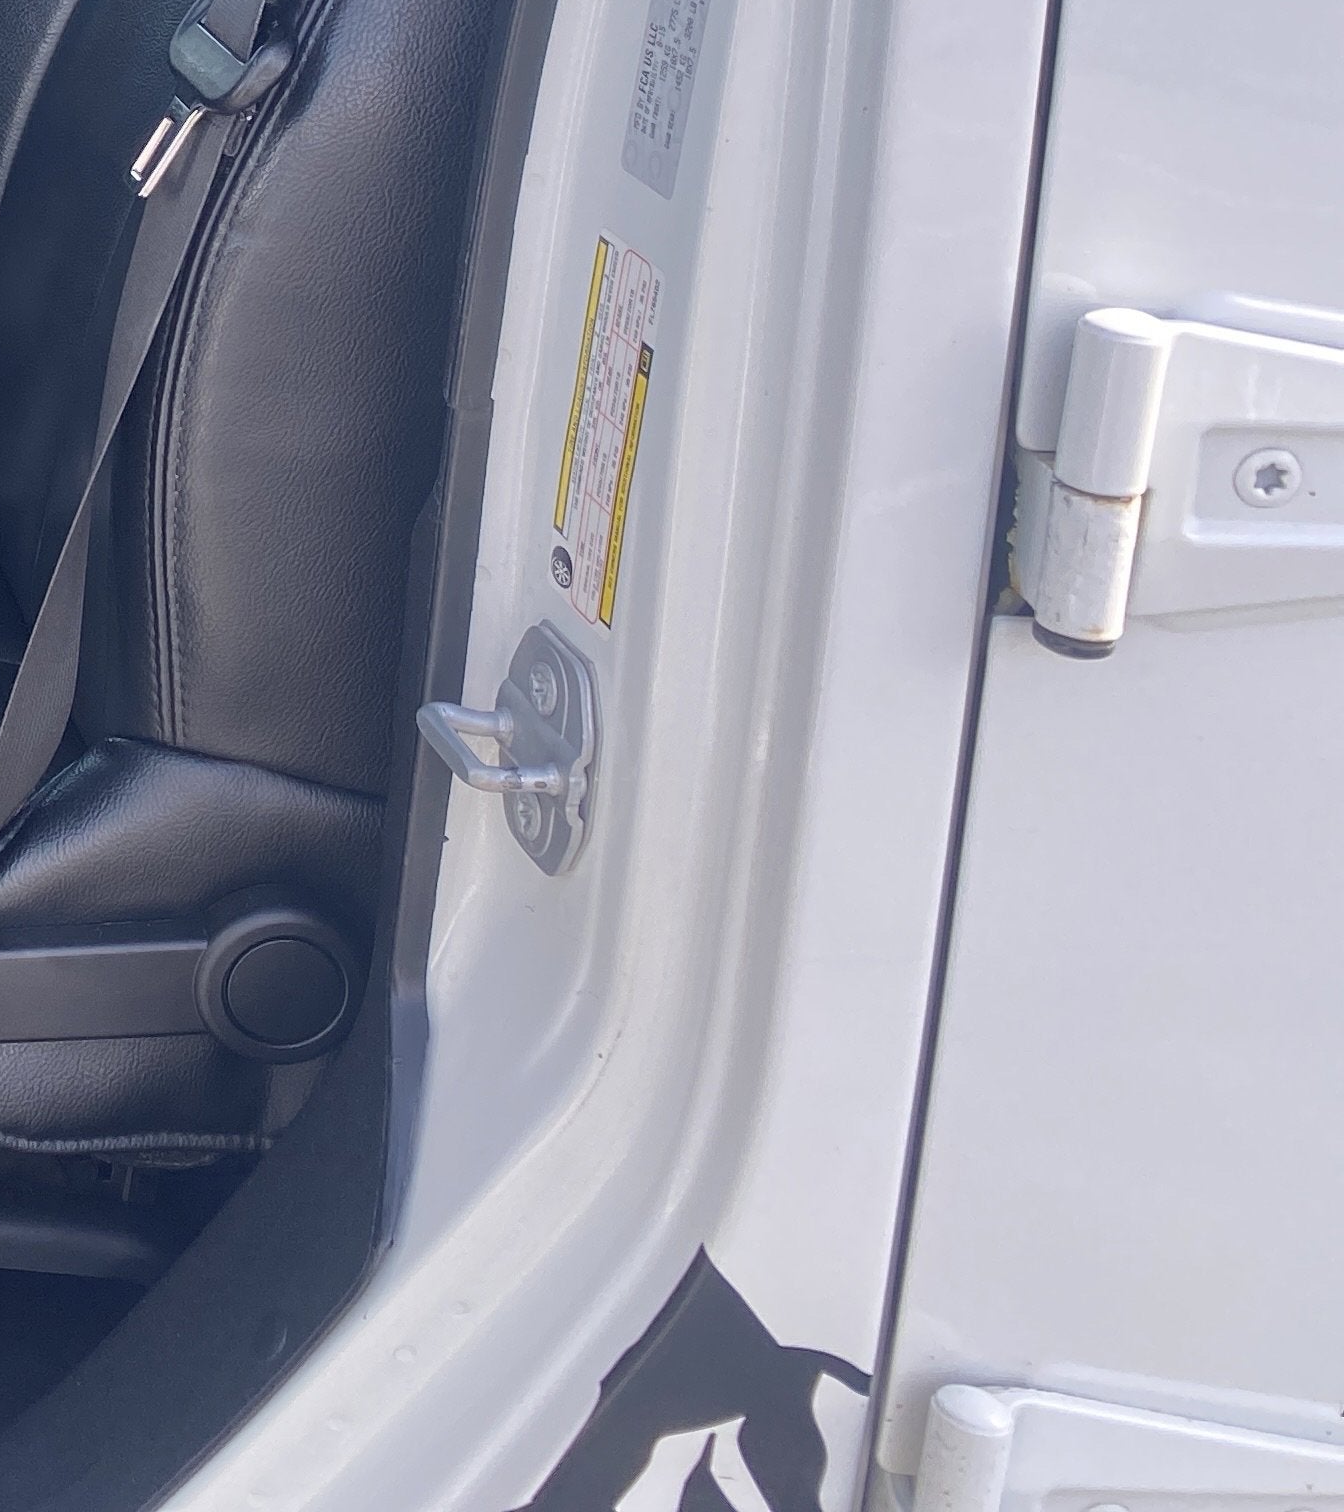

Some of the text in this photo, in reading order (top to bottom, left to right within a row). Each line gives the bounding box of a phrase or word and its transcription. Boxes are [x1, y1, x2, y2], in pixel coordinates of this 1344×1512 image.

[647, 21, 658, 46] LLC
[643, 48, 653, 67] US
[638, 68, 649, 94] FCA
[637, 96, 644, 109] BY
